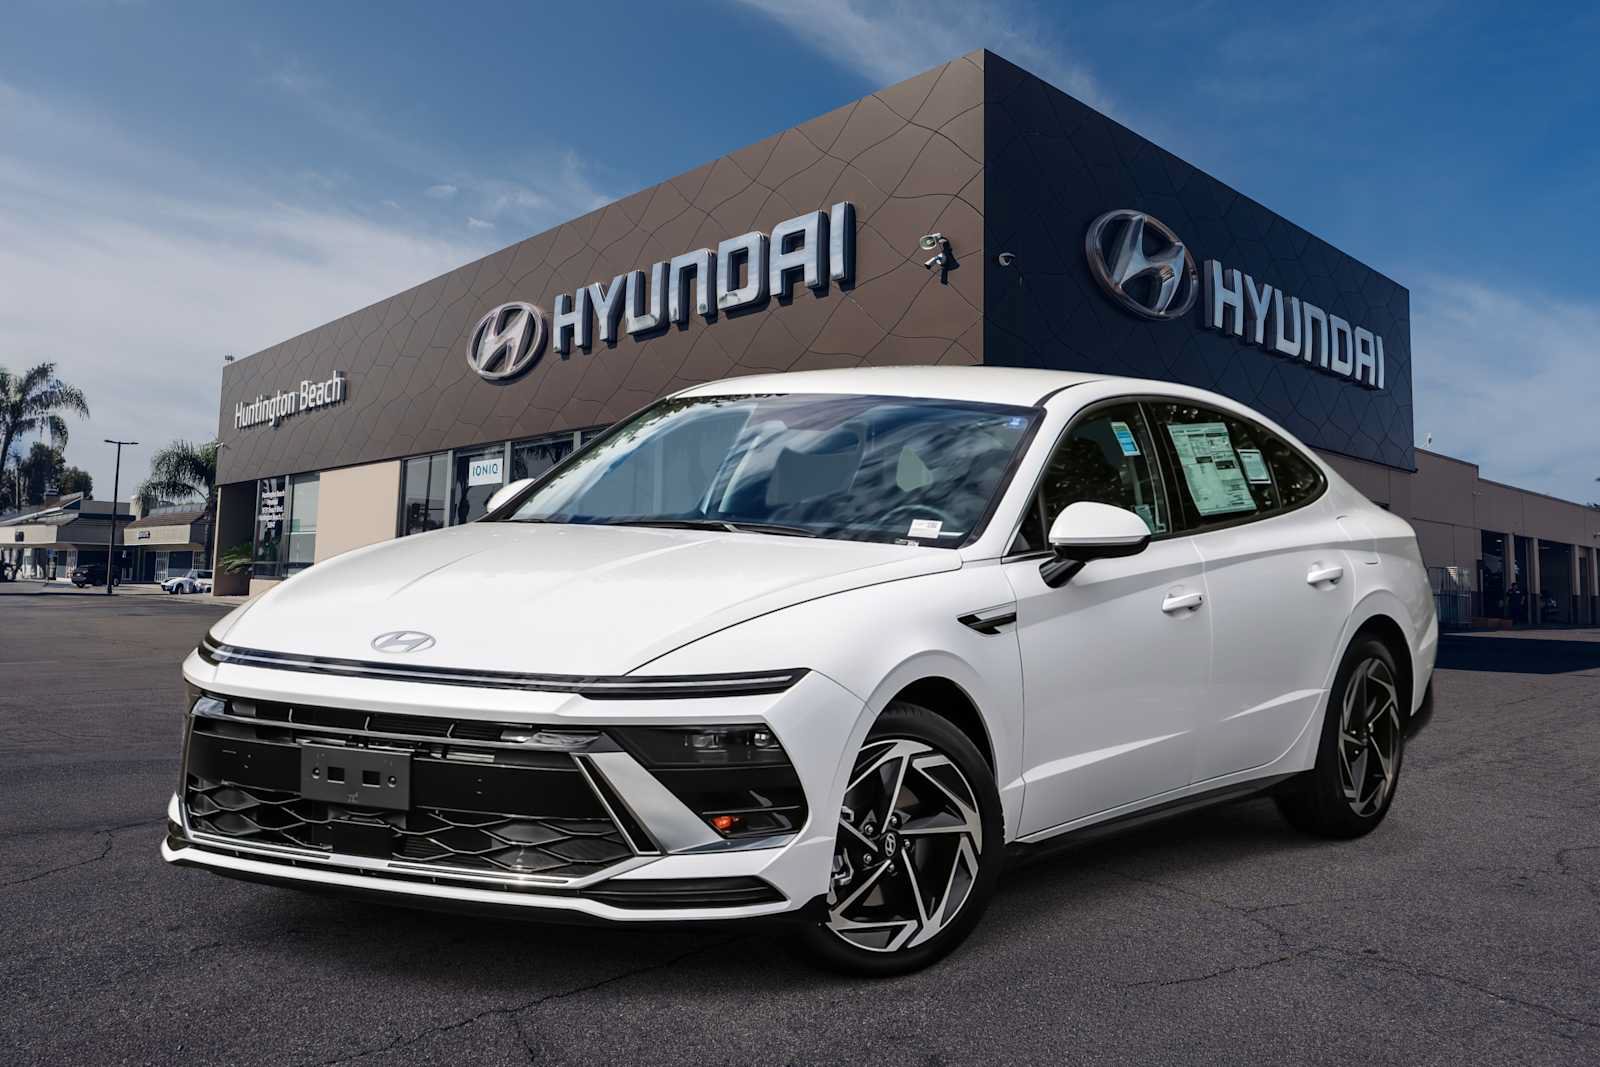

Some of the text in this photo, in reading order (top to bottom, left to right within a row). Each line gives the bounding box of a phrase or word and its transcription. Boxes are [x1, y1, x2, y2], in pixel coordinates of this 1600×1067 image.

[553, 201, 855, 353] HYUNDAI
[1204, 258, 1385, 390] HYUNDAI
[234, 370, 345, 429] Huntington Beach
[472, 463, 499, 477] IONIQ
